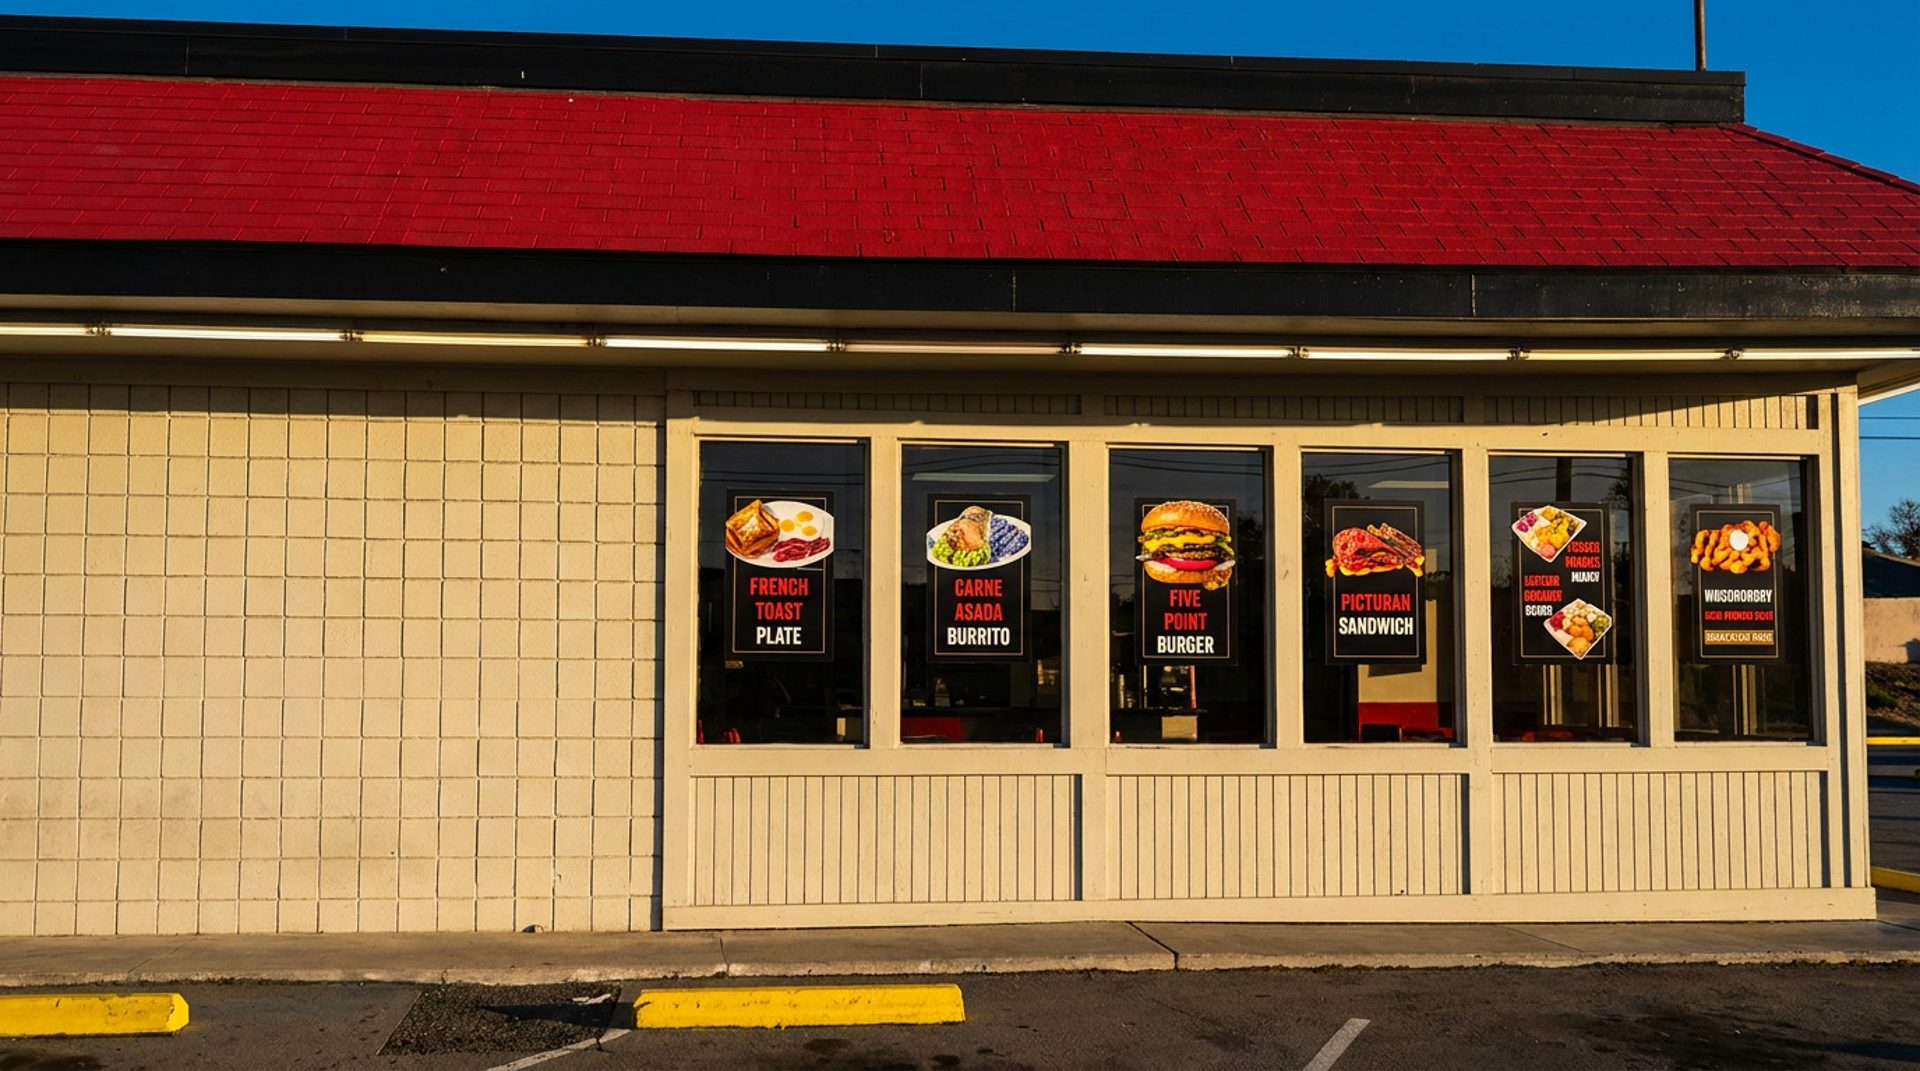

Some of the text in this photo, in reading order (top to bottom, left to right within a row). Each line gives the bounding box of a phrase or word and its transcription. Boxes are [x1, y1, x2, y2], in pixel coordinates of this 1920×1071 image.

[749, 576, 809, 596] FRENCH
[954, 578, 1003, 598] CARNE
[1169, 589, 1201, 608] FIVE
[1341, 593, 1411, 612] PICTURAN
[755, 601, 803, 621] TOAST
[954, 603, 1003, 622] ASADA
[1164, 612, 1208, 631] POINT
[1338, 616, 1414, 636] SANDWICH
[756, 626, 802, 645] PLATE
[947, 626, 1010, 646] BURRITO
[1157, 635, 1214, 654] BURGER
